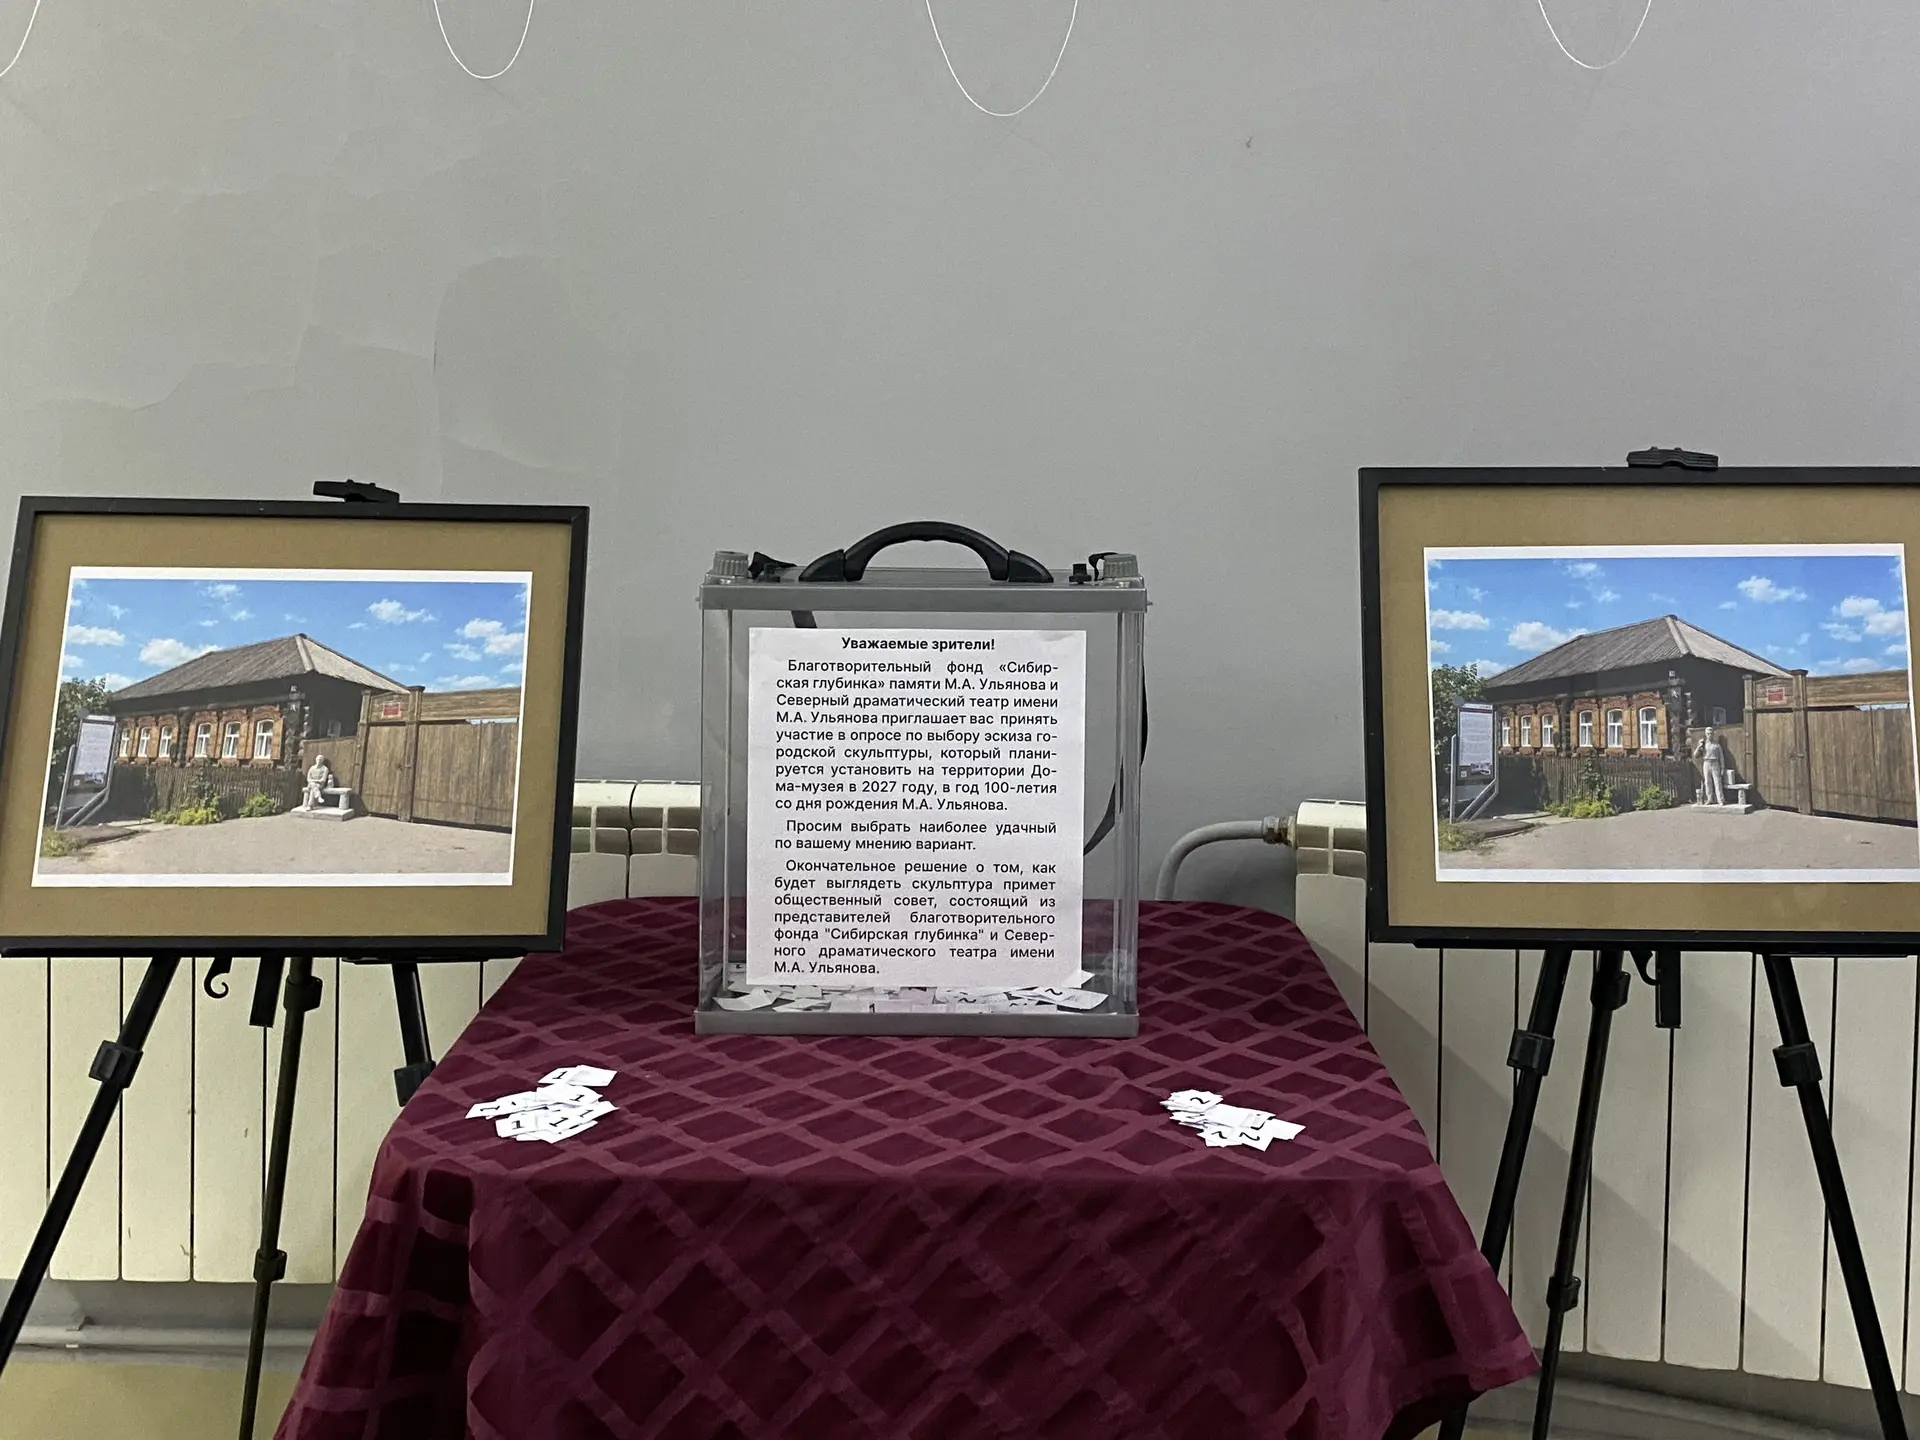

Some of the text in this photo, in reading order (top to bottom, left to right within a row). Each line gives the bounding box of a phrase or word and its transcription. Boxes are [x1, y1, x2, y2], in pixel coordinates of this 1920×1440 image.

[841, 636, 995, 653] Уважаемые зрители!
[788, 659, 1059, 677] Благотворительный фонд «Сибир-
[776, 676, 1059, 692] ская глубинка» памяти М.А. Ульянова и
[776, 693, 1058, 711] Северный драматический театр имени
[776, 710, 1058, 728] М.А. Ульянова приглашает вас принять
[775, 729, 1058, 745] участие в опросе по выбору эскиза го-
[775, 745, 1058, 762] родской скульптуры, который плани-
[775, 761, 1058, 780] руется установить на территории До-
[775, 780, 1057, 796] ма-музея в 2027 году, в год 100-летия
[775, 797, 1008, 813] со дня рождения М.А. Ульянова.
[786, 819, 1057, 837] Просим выбрать наиболее удачный
[774, 839, 977, 853] по вашему мнению вариант.
[785, 859, 1057, 877] Окончательное решение о том, как
[774, 876, 1057, 893] будет выглядеть скульптура примет
[774, 892, 1056, 910] общественный совет, состоящий из
[773, 910, 1056, 927] представителей благотворительного
[773, 927, 1055, 944] фонда "Сибирская глубинка" и Север-
[773, 943, 1055, 960] ного драматического театра имени
[773, 960, 880, 975] М.А. Ульянова.
[552, 1070, 568, 1080] 1
[569, 1094, 585, 1102] 1
[548, 1116, 569, 1127] 1
[578, 1109, 594, 1118] 1
[511, 1120, 525, 1130] 1
